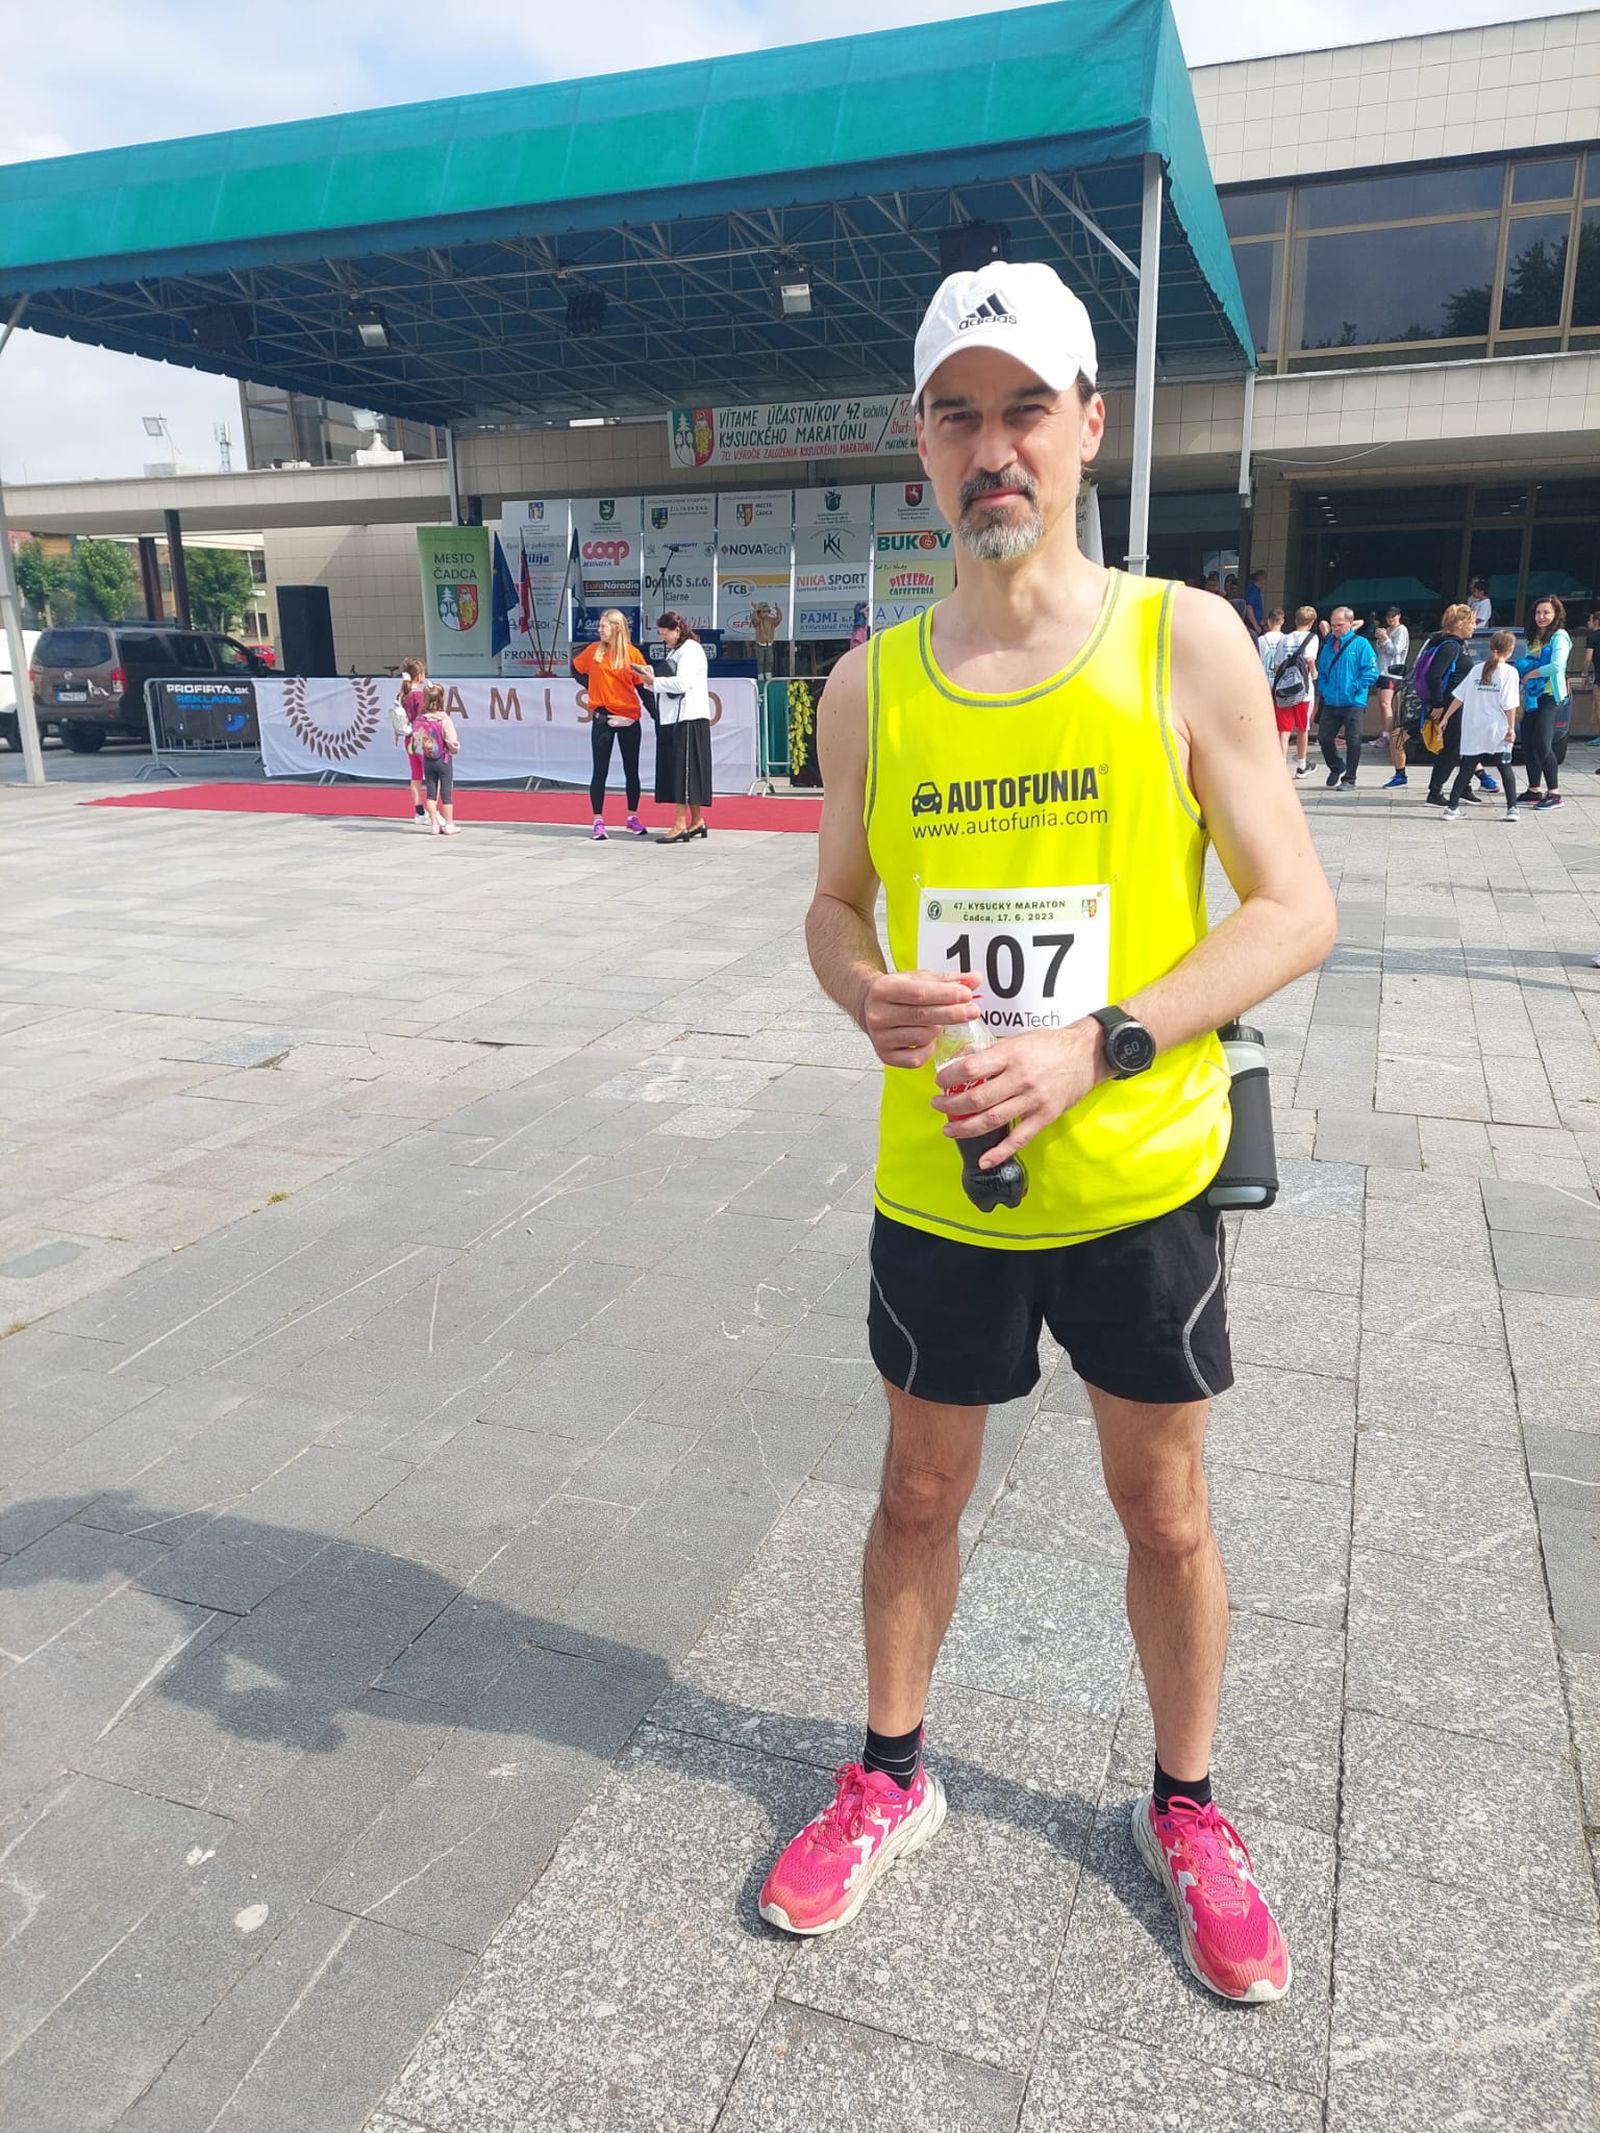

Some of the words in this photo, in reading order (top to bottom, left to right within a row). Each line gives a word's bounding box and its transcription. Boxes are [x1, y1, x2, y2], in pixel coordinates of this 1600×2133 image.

[959, 314, 1018, 330] adidas
[720, 408, 758, 429] VÍTAME
[767, 402, 841, 425] ÚČASTNÍKOV
[846, 402, 860, 420] 47.
[719, 426, 787, 449] KYSUCKÉHO
[795, 420, 867, 443] MARATÓNU
[730, 542, 787, 556] NOVATech
[877, 532, 952, 551] BUKOV
[433, 553, 475, 564] MESTO
[582, 540, 630, 566] coop
[433, 567, 477, 579] ČADCA
[796, 575, 826, 587] NIKA
[827, 573, 867, 586] SPORT
[889, 572, 935, 588] PIZZERIA
[686, 577, 711, 588] s.r.o.
[728, 584, 748, 595] TCB
[800, 612, 839, 624] PAJMI
[947, 766, 1099, 814] AUTOFUNIA
[912, 807, 1109, 840] www.autofunia.com
[968, 901, 1011, 911] KYSUCKÝ
[1015, 899, 1066, 910] MARATÓN
[963, 912, 994, 923] Čadca,
[997, 914, 1011, 922] 17.
[1027, 912, 1055, 921] 2023
[946, 932, 1075, 1000] 107
[980, 1010, 1061, 1028] NOVATech
